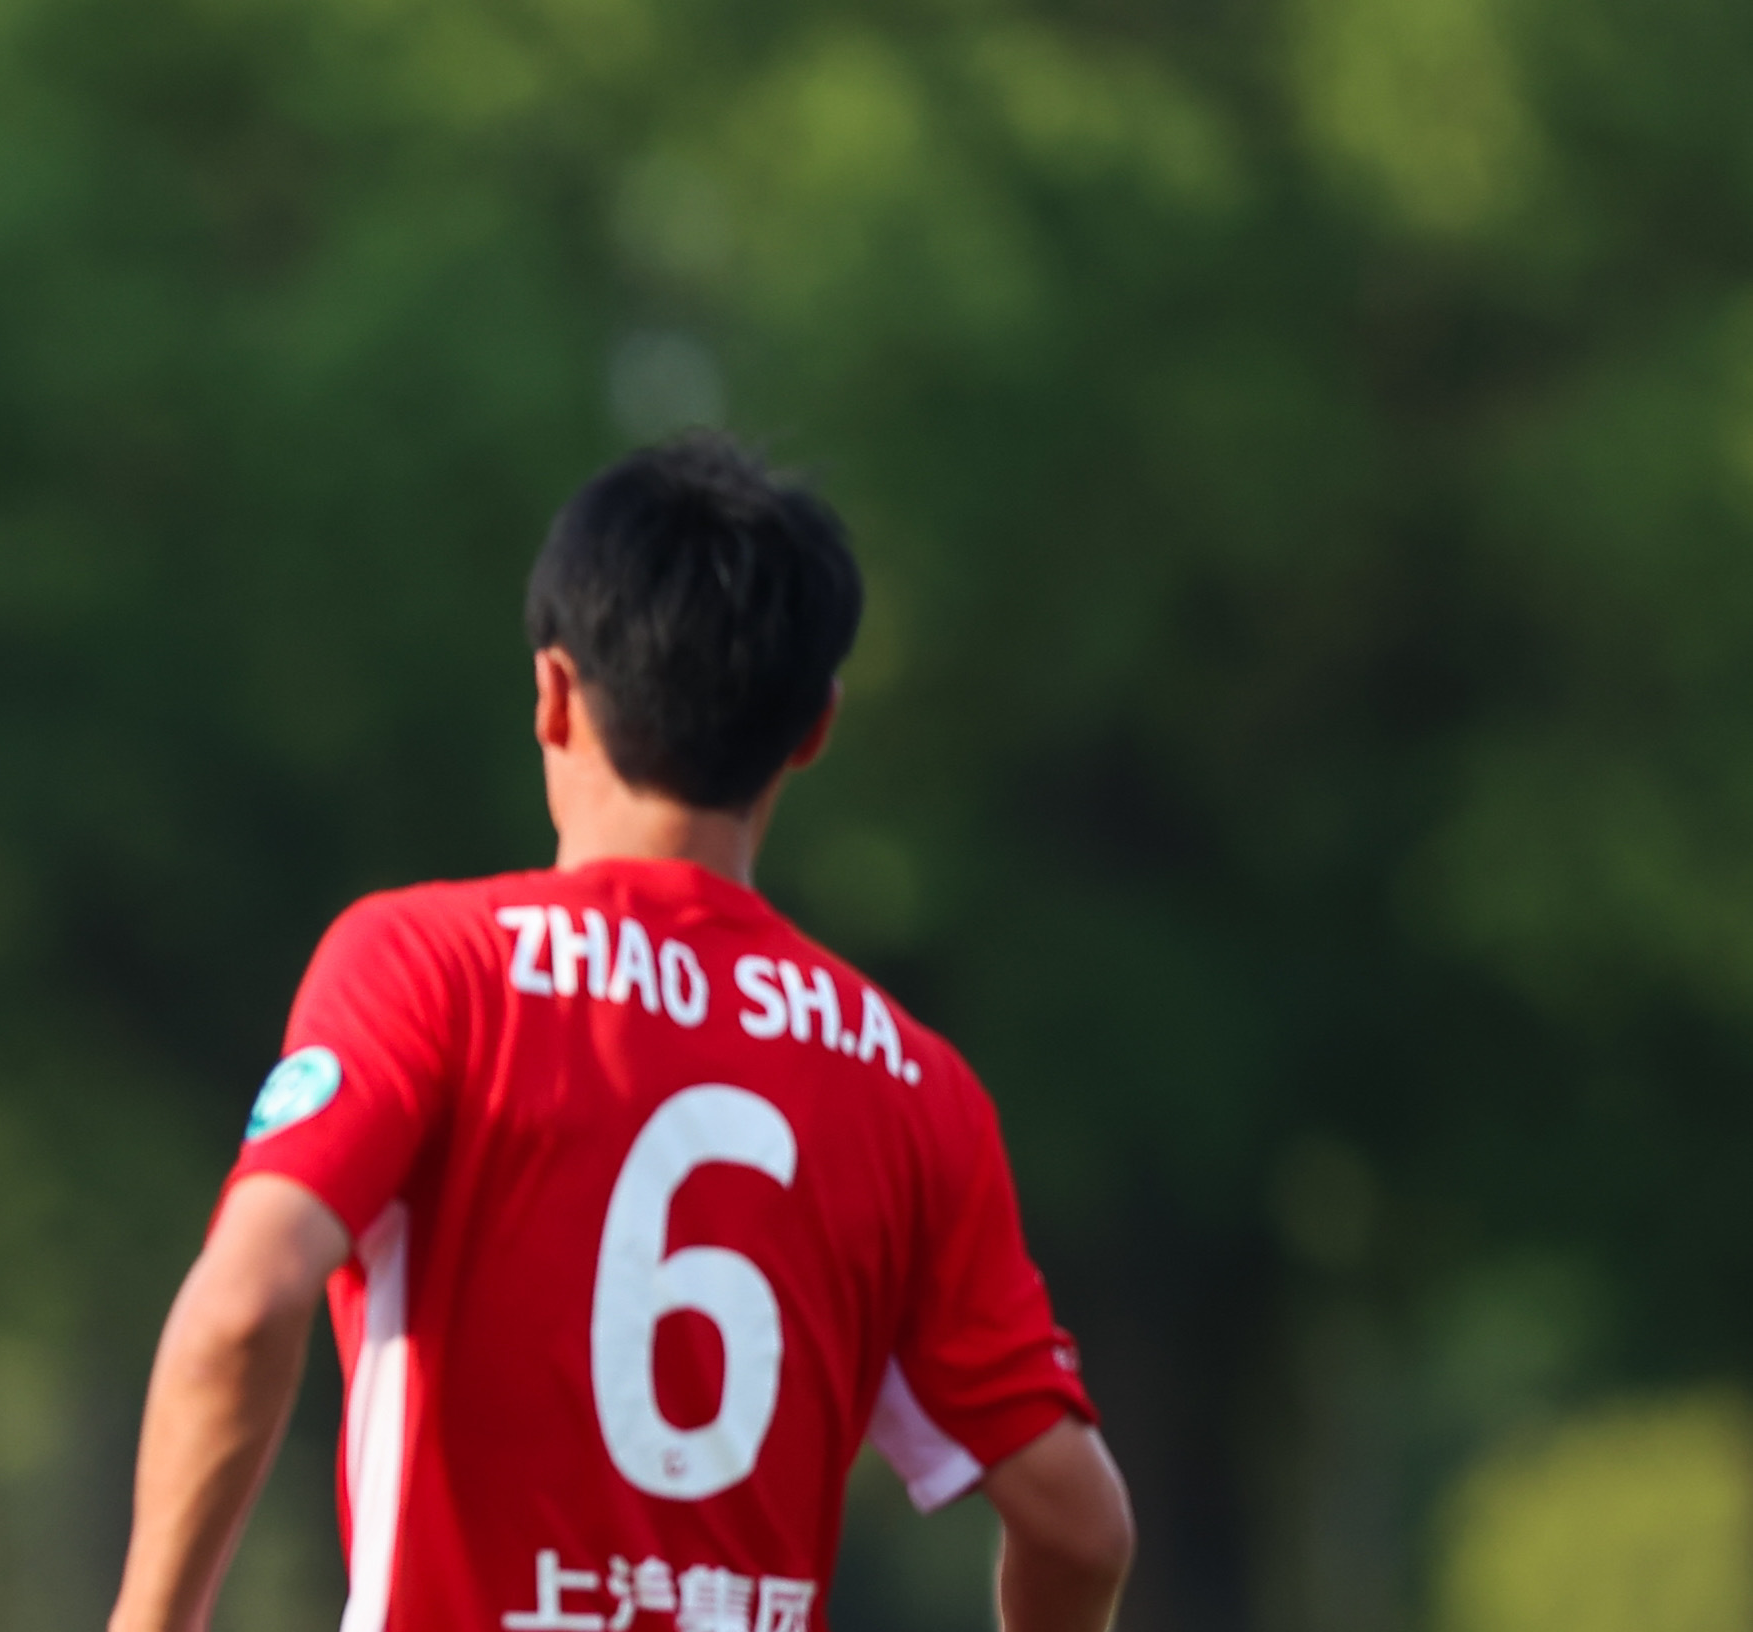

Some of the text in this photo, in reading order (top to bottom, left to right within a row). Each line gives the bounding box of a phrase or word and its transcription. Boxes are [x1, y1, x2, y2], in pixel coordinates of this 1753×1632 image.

[494, 904, 923, 1087] ZHAO SH.A.
[591, 1081, 798, 1501] 6
